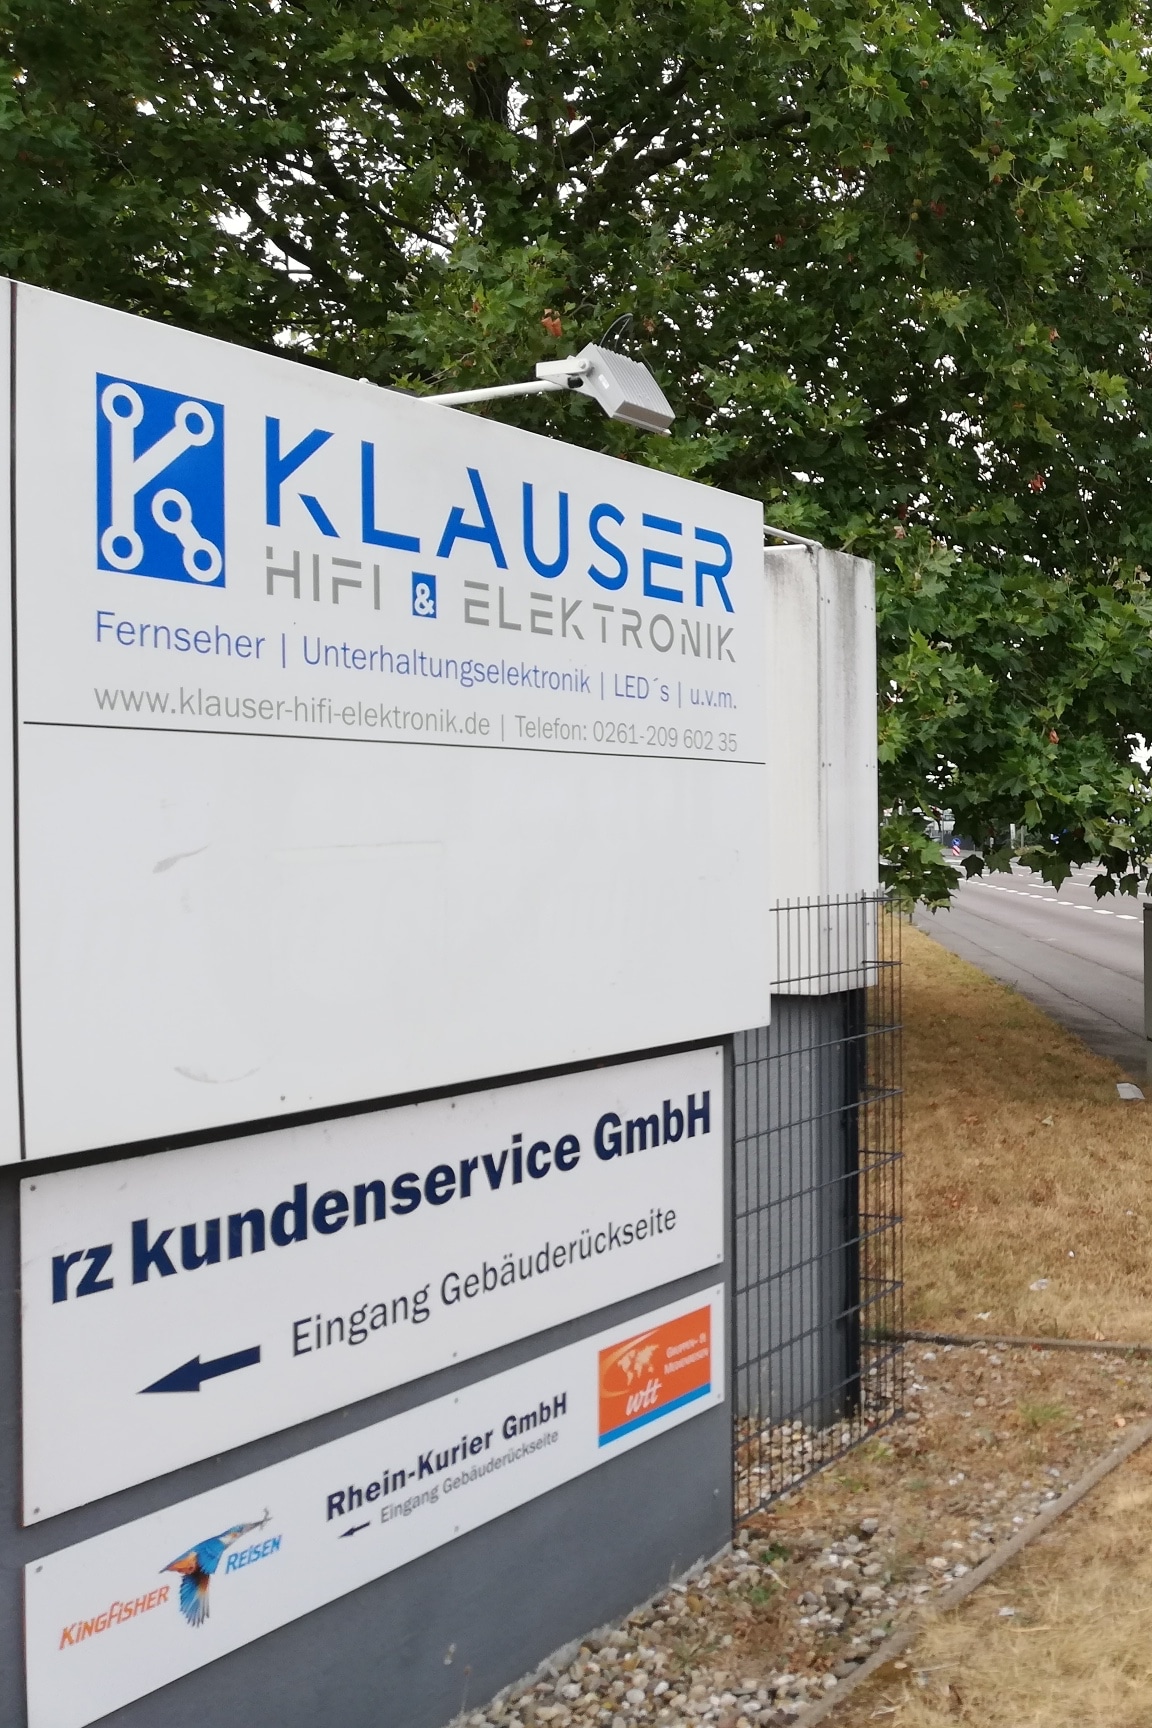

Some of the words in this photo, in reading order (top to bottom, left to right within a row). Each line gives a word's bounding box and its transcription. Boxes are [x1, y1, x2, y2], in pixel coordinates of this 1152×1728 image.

[265, 415, 735, 613] KLAUSER
[96, 610, 265, 659] Fernseher
[303, 635, 591, 694] Unterhaltungselektronik
[690, 687, 738, 710] u.v.m.
[265, 545, 381, 610] HIFI
[464, 580, 736, 662] ELEKTRONIK
[94, 687, 490, 736] www.klauser-hifi-elektronik.de
[515, 714, 587, 742] Telefon:
[593, 720, 678, 748] 0261-209
[683, 729, 714, 751] 602
[718, 732, 738, 753] 35
[52, 1243, 114, 1305] rz
[131, 1132, 581, 1285] kundenservice
[593, 1090, 711, 1161] GmbH
[293, 1283, 431, 1357] Eingang
[440, 1207, 677, 1306] Gebäuderückseite
[326, 1429, 494, 1522] Rhein-Kurier
[502, 1391, 568, 1441] GmbH
[380, 1483, 440, 1524] Eingang
[443, 1429, 560, 1495] Gebäuderückseite
